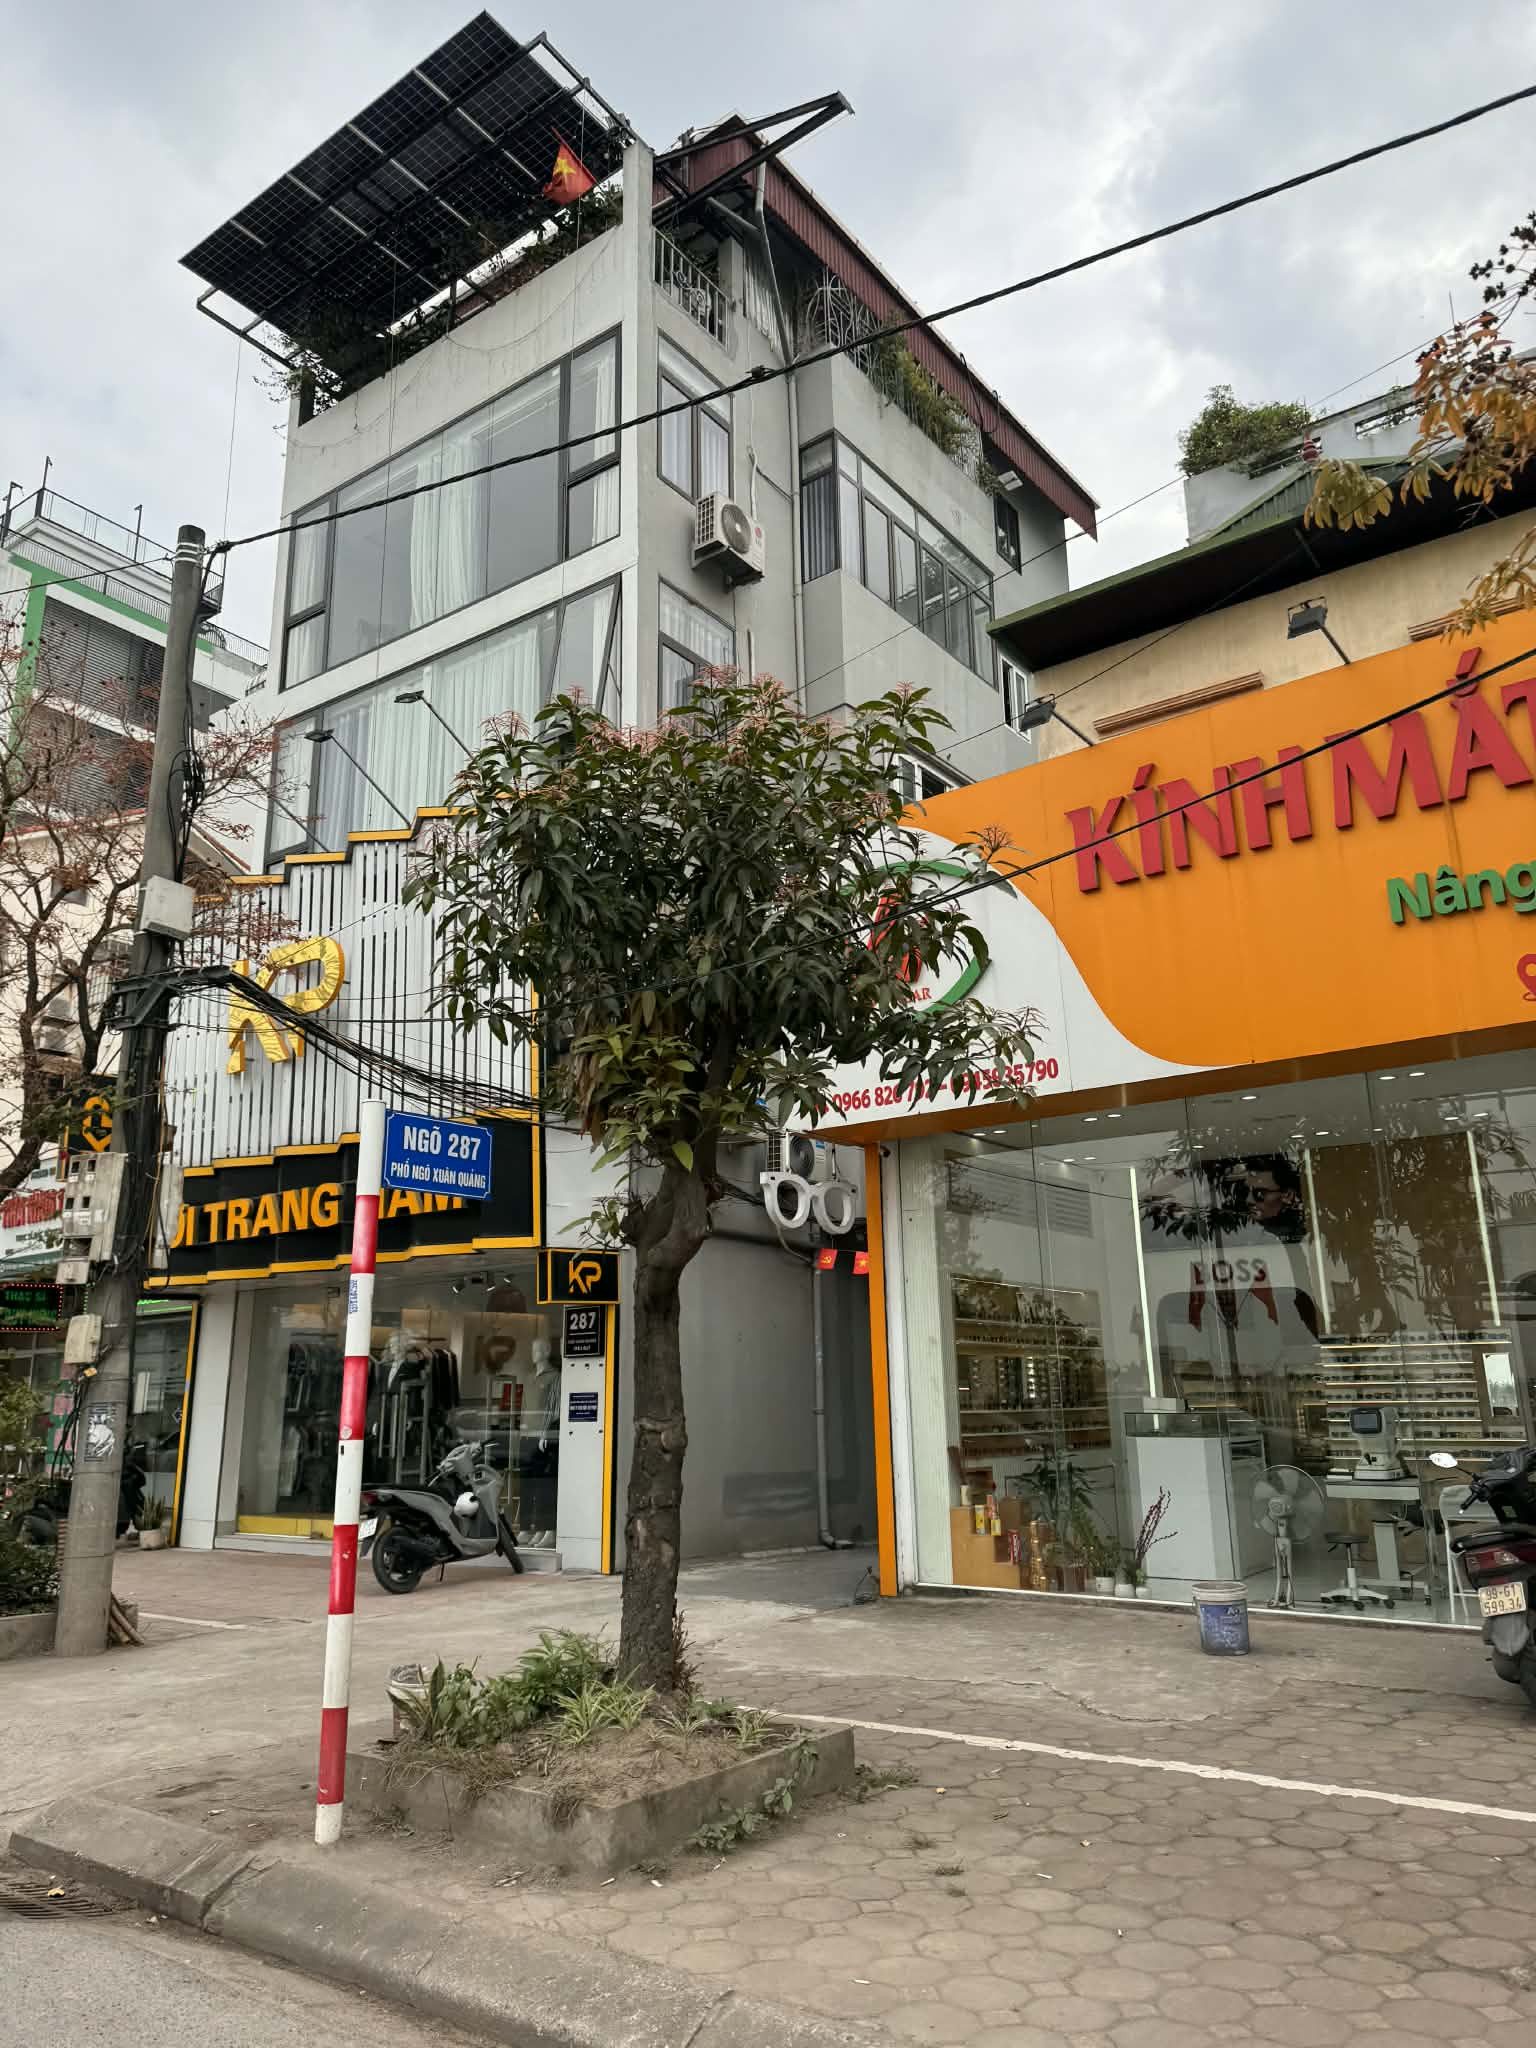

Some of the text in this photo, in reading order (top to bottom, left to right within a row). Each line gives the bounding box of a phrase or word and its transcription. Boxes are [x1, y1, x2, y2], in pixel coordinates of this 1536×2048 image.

[1064, 763, 1313, 893] KÍNH
[1386, 860, 1536, 925] Nâng
[832, 1088, 871, 1112] 0966
[403, 1125, 481, 1161] NGÕ 287
[390, 1157, 410, 1178] PHỐ
[432, 1166, 457, 1185] XUÂN
[457, 1168, 486, 1189] QUẢNG
[203, 1182, 342, 1244] TRANG
[569, 1311, 597, 1330] 287
